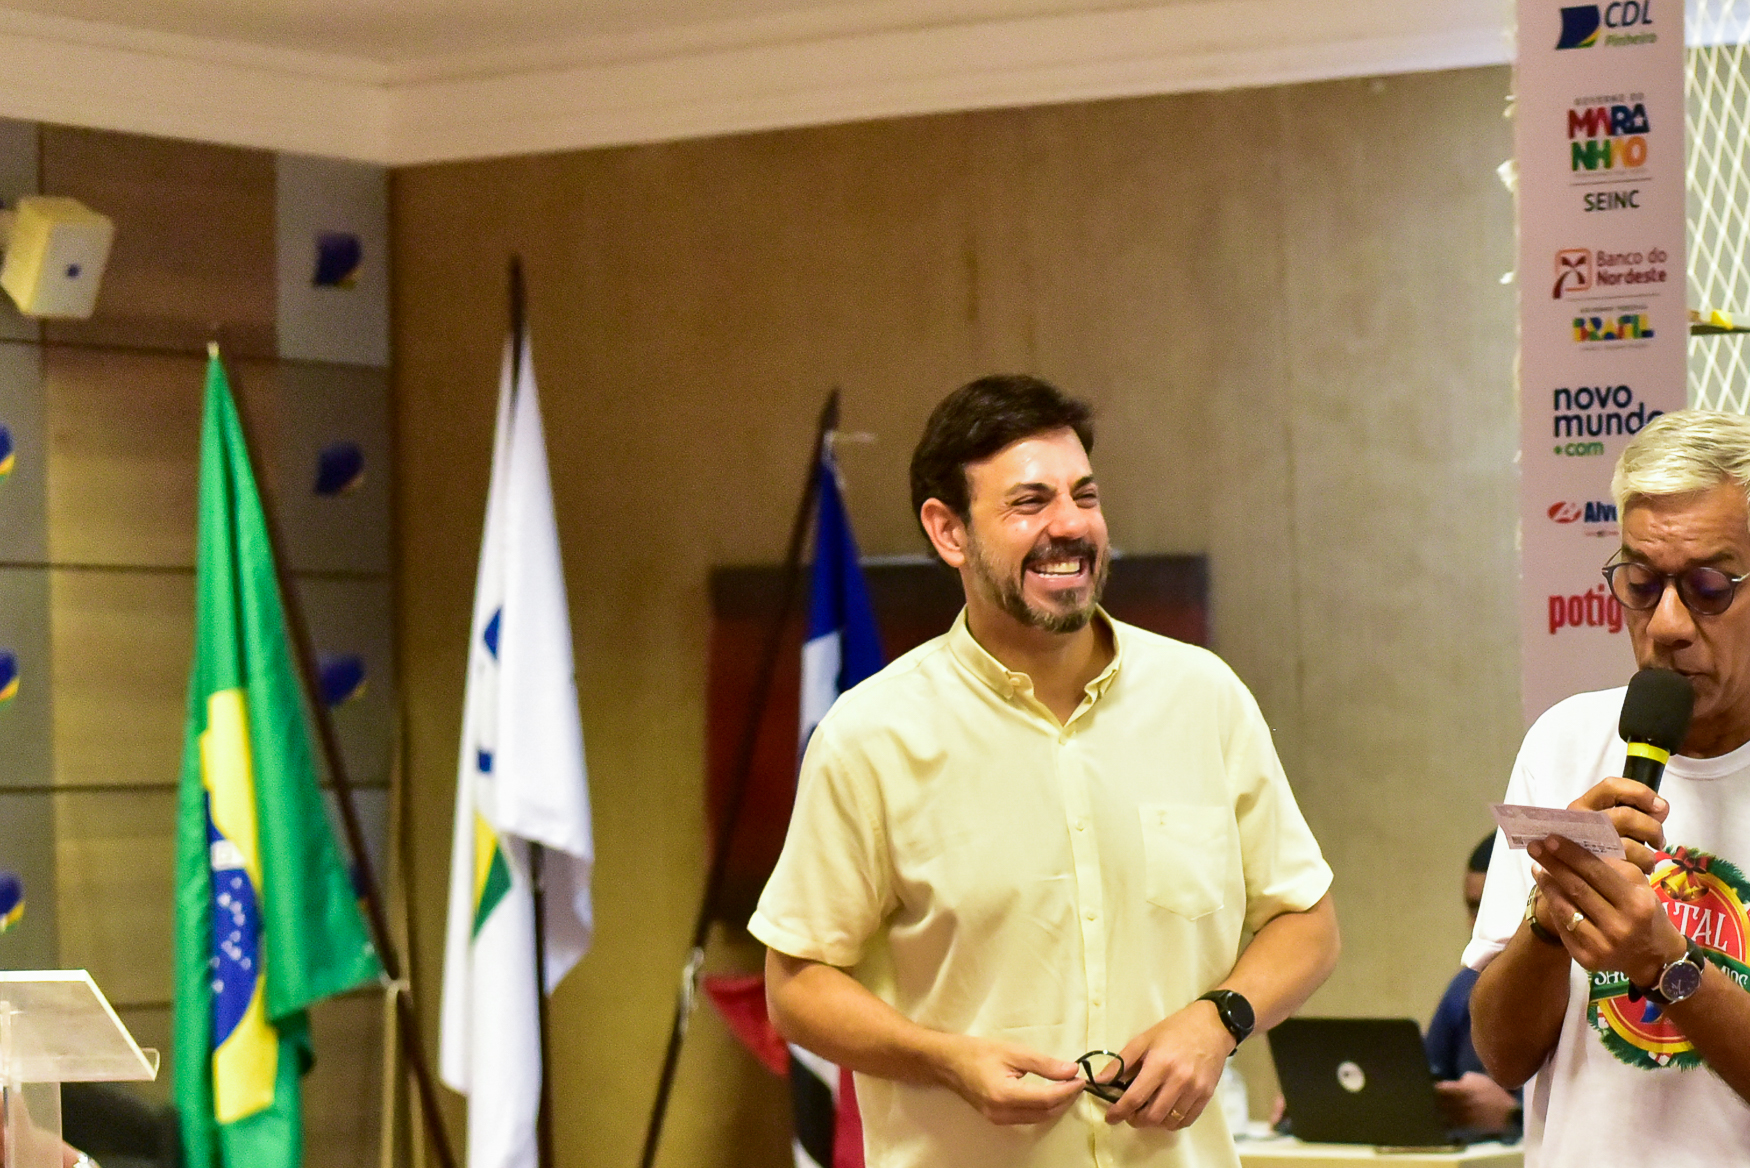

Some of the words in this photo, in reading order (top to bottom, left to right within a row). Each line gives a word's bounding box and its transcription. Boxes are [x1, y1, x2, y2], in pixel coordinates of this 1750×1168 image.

[1604, 0, 1653, 28] CDL
[1583, 190, 1641, 212] SEINC
[1597, 249, 1643, 267] Banco
[1647, 247, 1667, 264] do
[1597, 268, 1667, 286] Nordeste
[1554, 385, 1632, 411] novo
[1662, 901, 1728, 952] TAL
